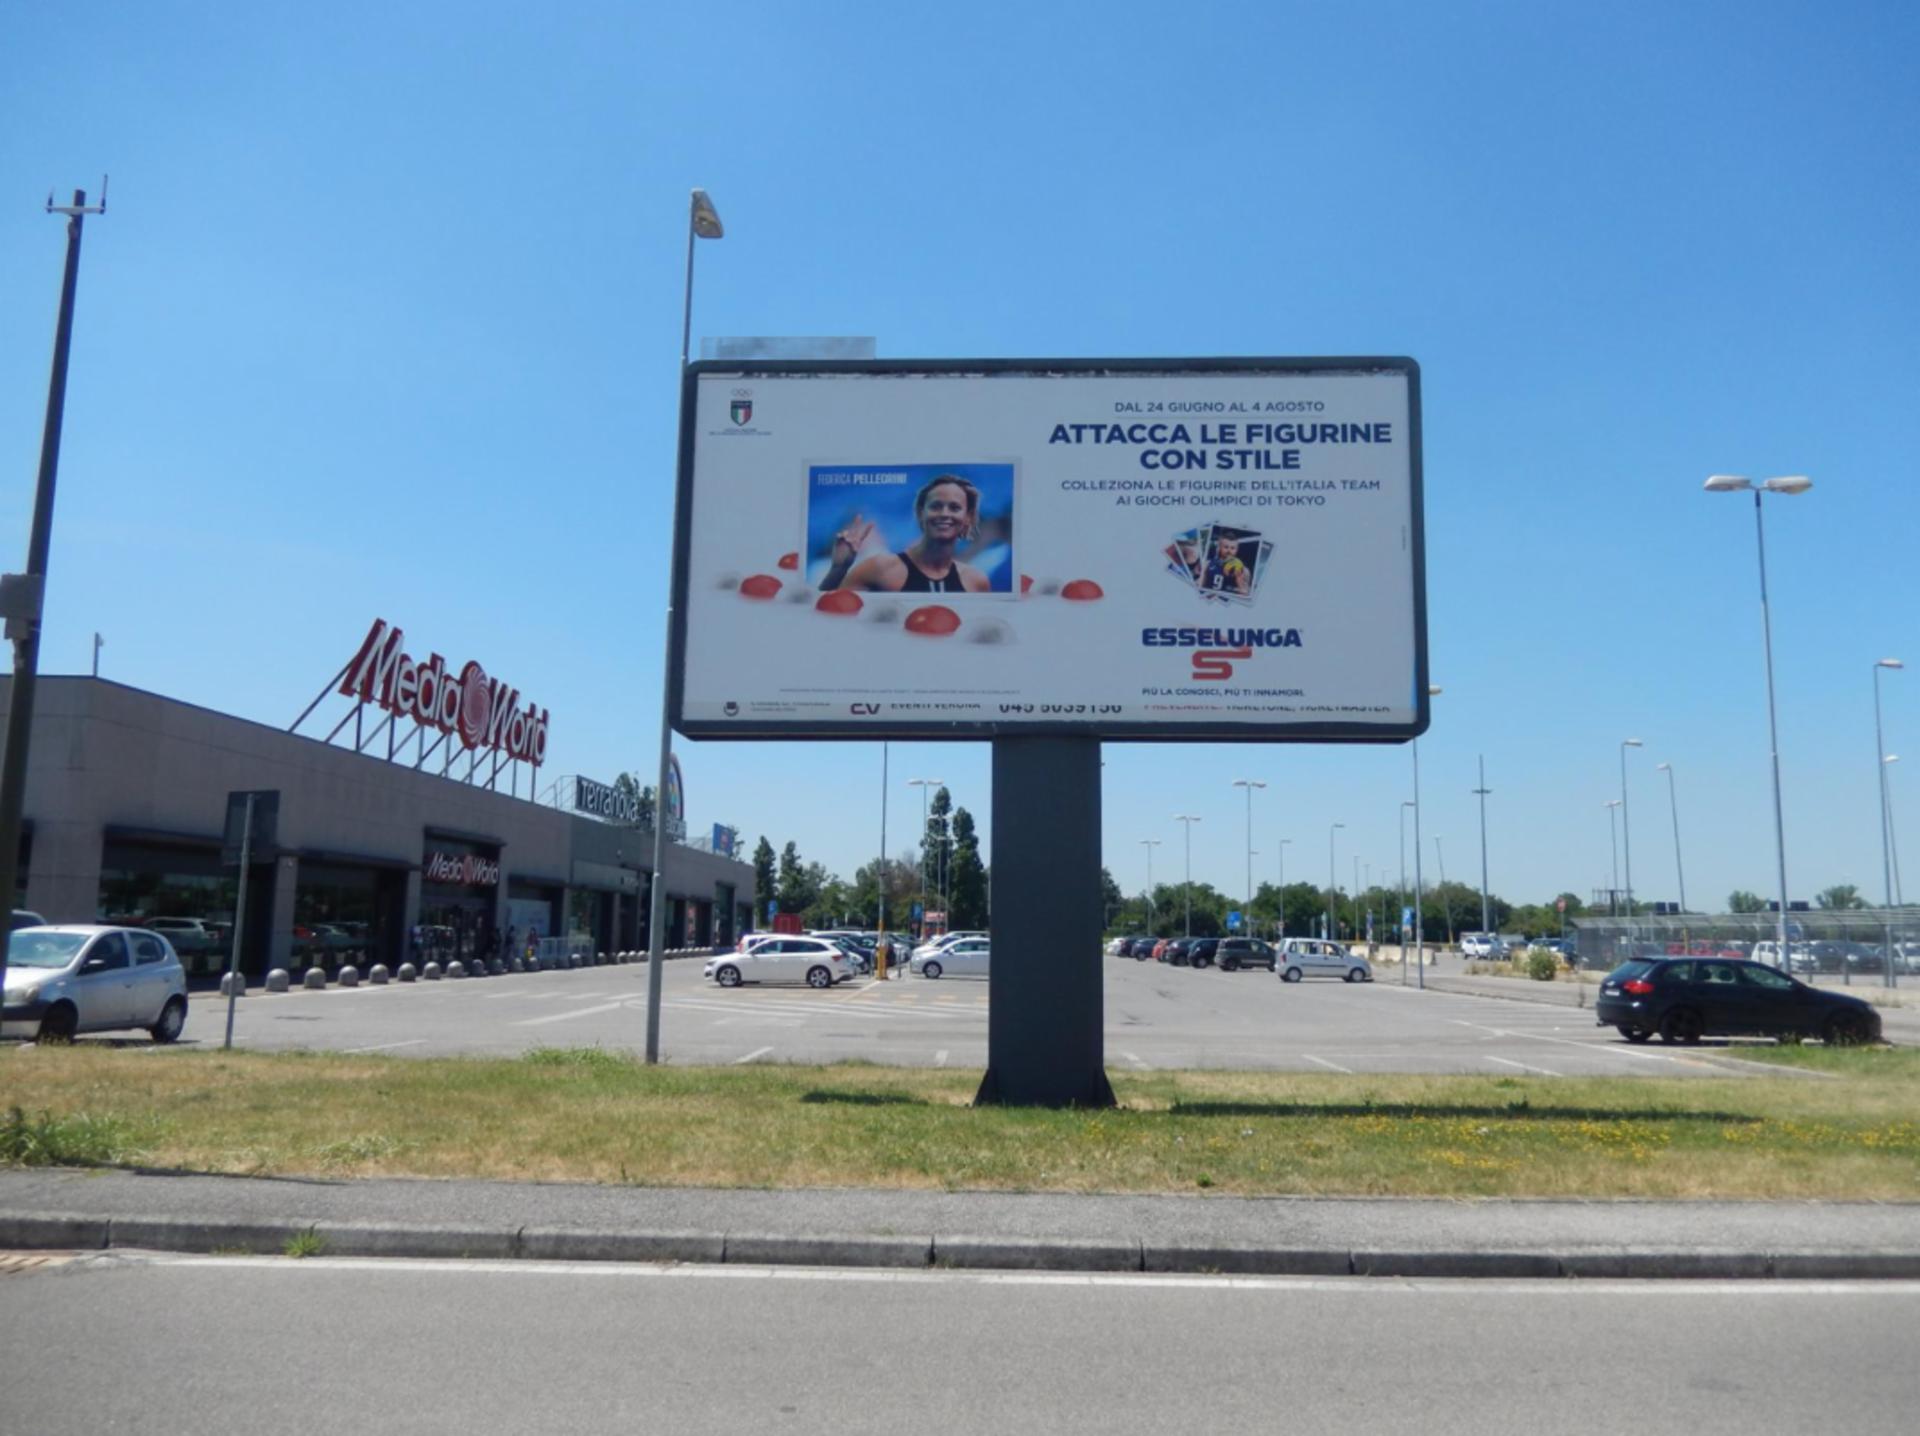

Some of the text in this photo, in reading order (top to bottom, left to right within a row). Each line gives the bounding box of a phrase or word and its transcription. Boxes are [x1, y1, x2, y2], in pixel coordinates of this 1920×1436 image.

[1114, 400, 1325, 413] DAL 24 GIUGNO AL 4 AGOSTO
[1048, 422, 1393, 445] ATTACCA LE FIGURINE
[1139, 448, 1301, 470] CON STILE
[853, 472, 908, 485] PELLEGRINI
[1061, 479, 1381, 491] COLLEZIONA LE FIGURINE DELL'ITALIA TEAM
[1116, 495, 1326, 507] AI GIOCHI OLIMPICI DI TOKYO
[1142, 628, 1303, 648] ESSELUNGA
[339, 618, 551, 767] Media World
[1160, 688, 1173, 697] LA
